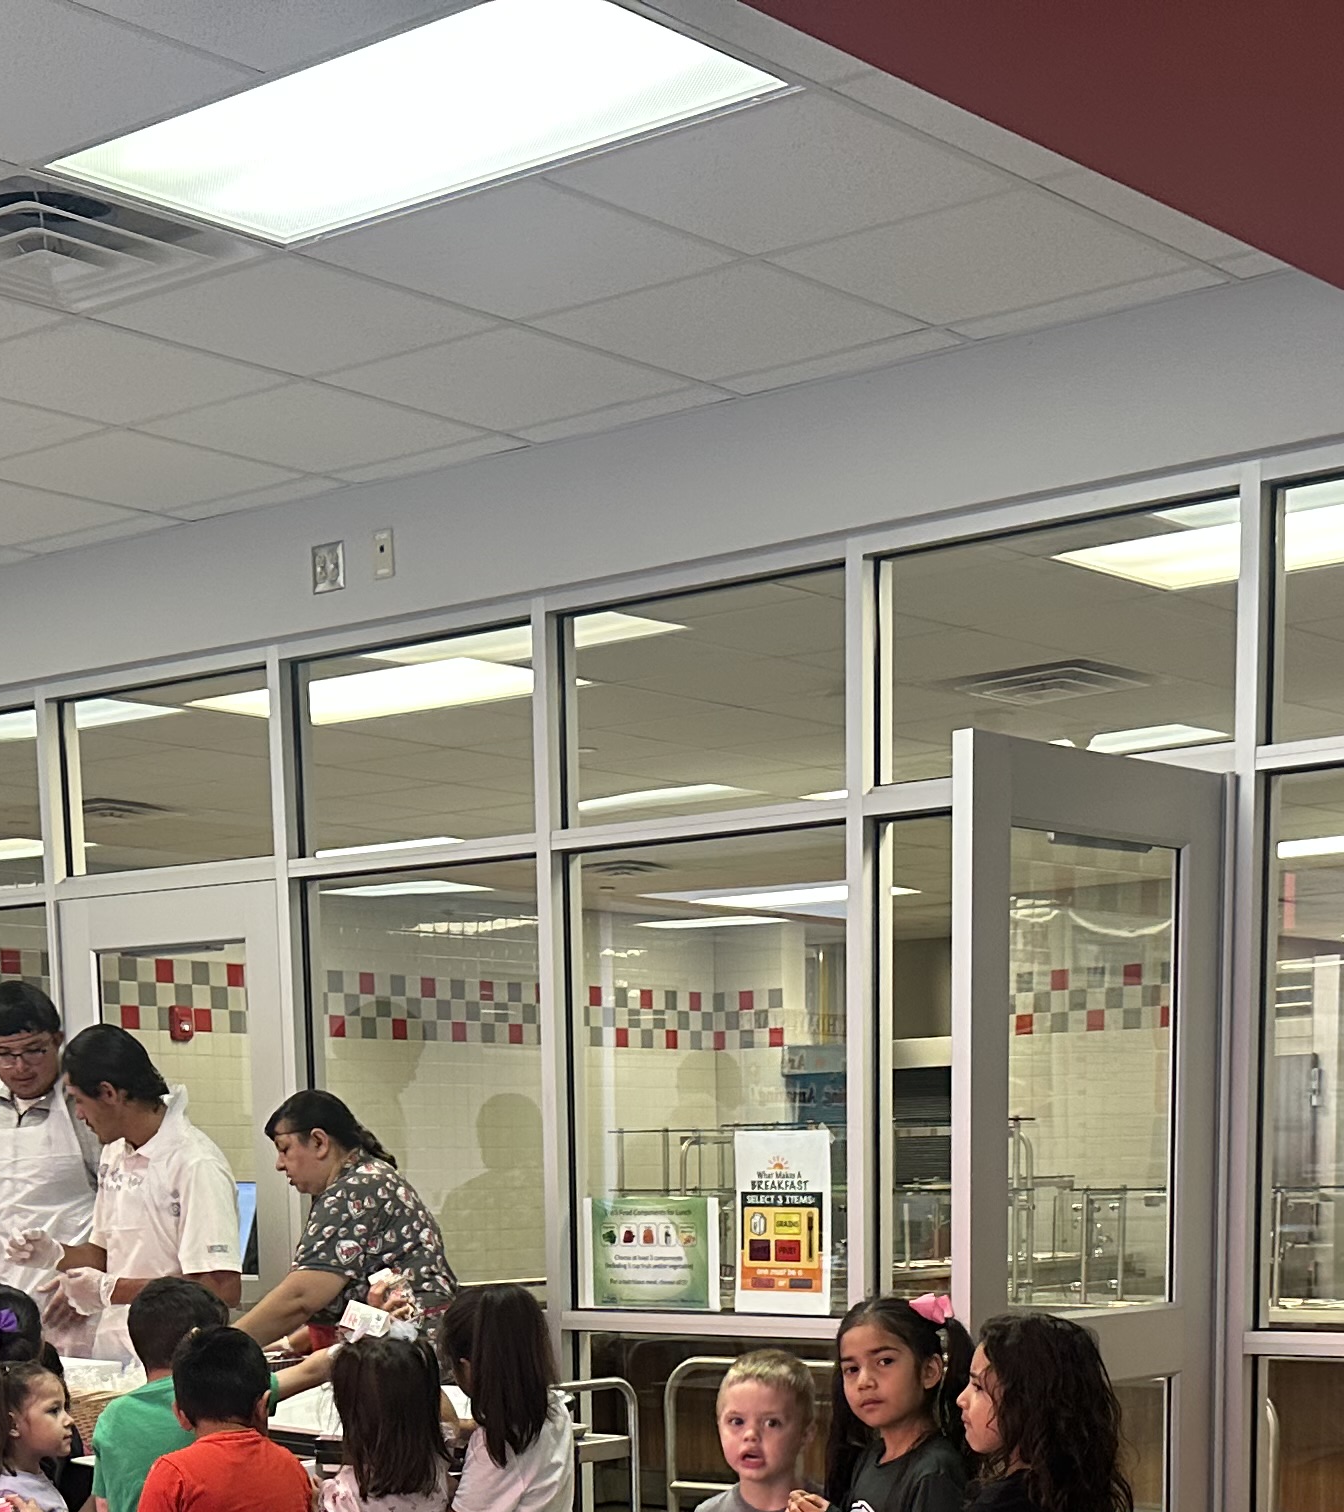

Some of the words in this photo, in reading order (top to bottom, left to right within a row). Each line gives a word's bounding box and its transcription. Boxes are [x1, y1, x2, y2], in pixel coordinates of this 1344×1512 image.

[757, 1171, 774, 1180] What
[776, 1171, 796, 1180] Makes
[797, 1171, 802, 1179] A
[751, 1180, 809, 1191] BREAKFAST
[746, 1195, 774, 1204] SELECT
[777, 1195, 783, 1205] 3
